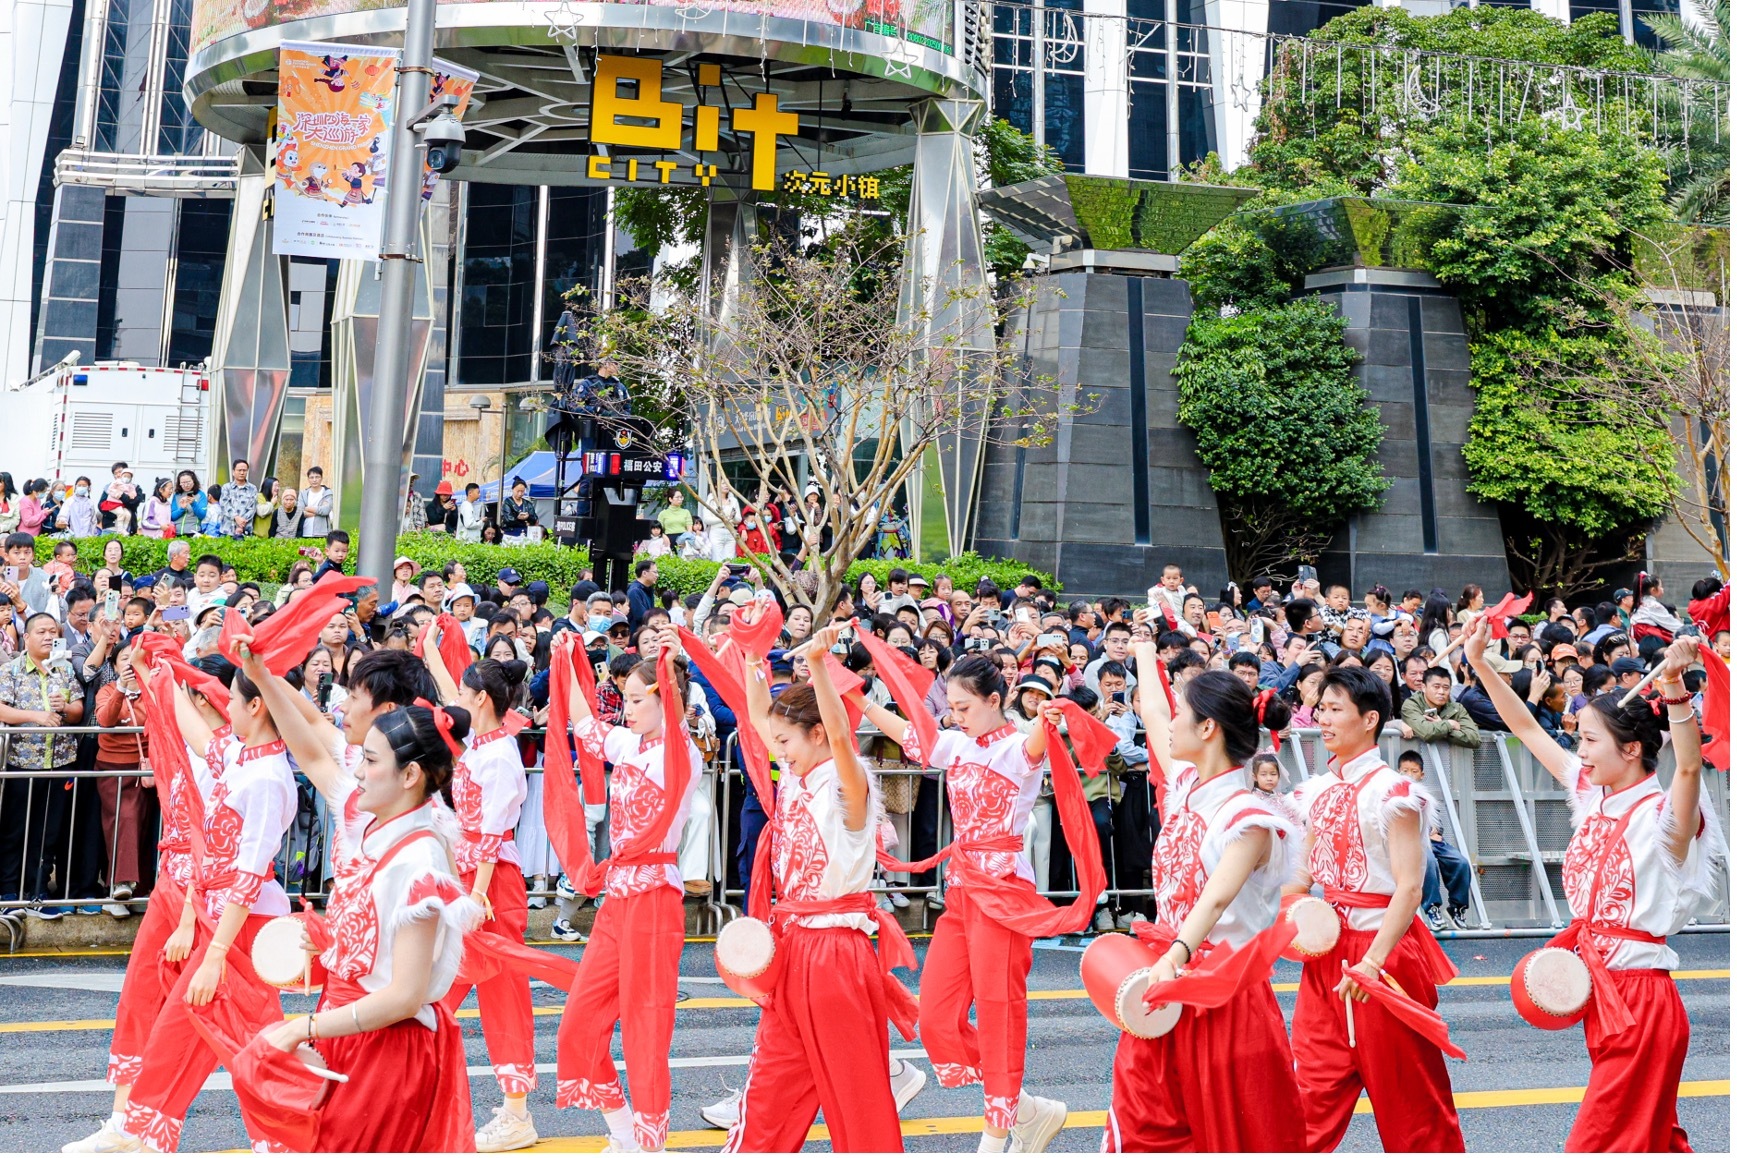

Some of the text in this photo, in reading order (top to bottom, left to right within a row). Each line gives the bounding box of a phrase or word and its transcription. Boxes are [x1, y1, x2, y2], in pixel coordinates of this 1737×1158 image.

[293, 112, 372, 135] 深圳四海一家
[304, 126, 358, 143] 大巡游
[590, 54, 799, 191] Bit
[586, 155, 717, 187] CITY
[783, 169, 880, 199] 次元小镇
[624, 459, 663, 473] 福田公安
